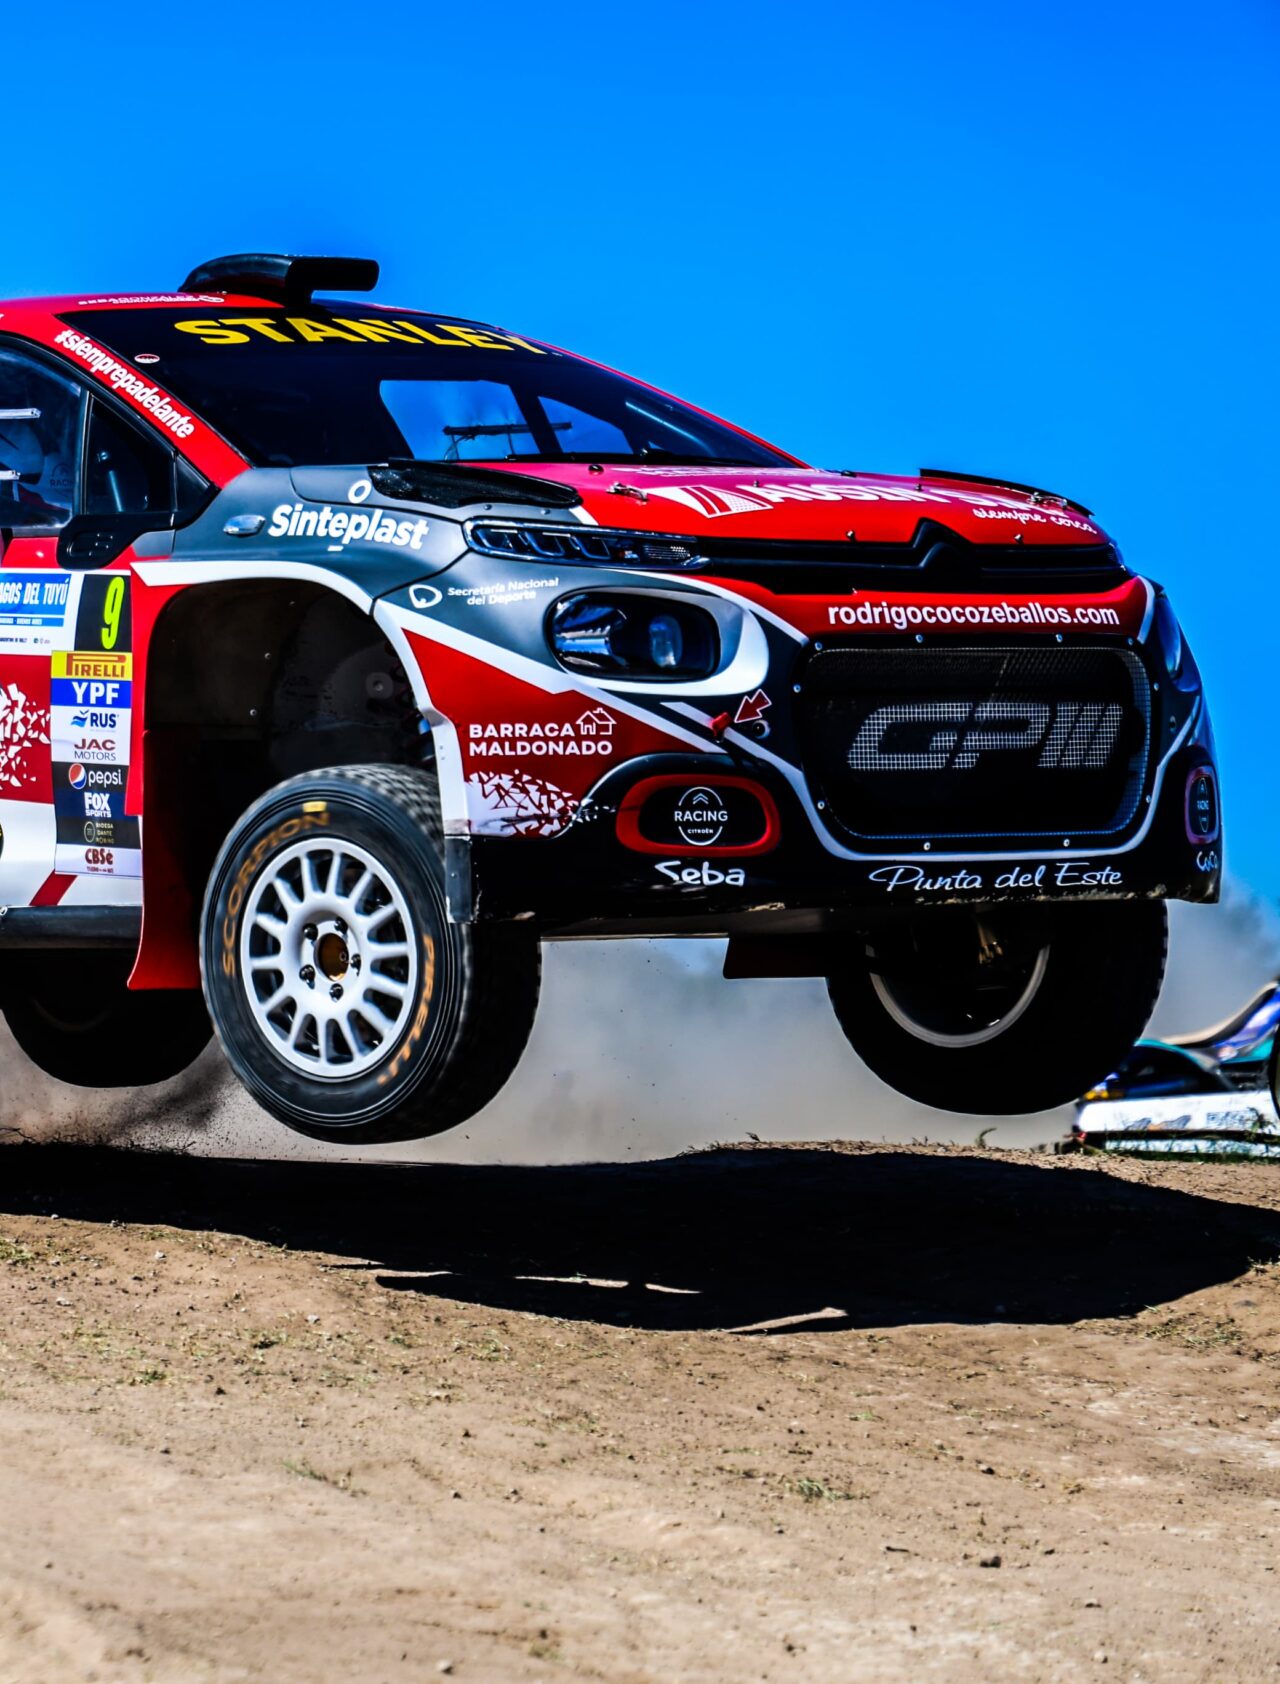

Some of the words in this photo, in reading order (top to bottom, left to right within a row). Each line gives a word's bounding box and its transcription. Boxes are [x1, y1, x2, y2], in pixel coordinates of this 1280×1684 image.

[174, 318, 548, 355] STANLEY
[54, 330, 195, 438] #siemprepadelante
[268, 503, 429, 550] Sinteplast
[23, 582, 40, 605] DEL
[43, 578, 70, 606] TUYÚ
[508, 577, 559, 591] Nacional
[467, 595, 485, 605] del
[101, 576, 125, 650] 9
[828, 601, 1120, 630] rodrigococozeballos.com
[66, 653, 127, 678] PIRELLI
[71, 681, 120, 705] YPF
[90, 712, 117, 728] RUS
[469, 722, 575, 738] BARRACA
[74, 738, 116, 751] JAC
[469, 740, 613, 756] MALDONADO
[74, 751, 116, 761] MOTORS
[89, 769, 122, 788] pepsi
[84, 792, 111, 811] FOX
[85, 809, 112, 818] SPORTS
[674, 810, 728, 822] RACING
[654, 861, 745, 887] Seba
[868, 865, 982, 892] Punta
[994, 864, 1046, 889] del
[1054, 862, 1123, 887] Este
[222, 812, 330, 977] SCORPION
